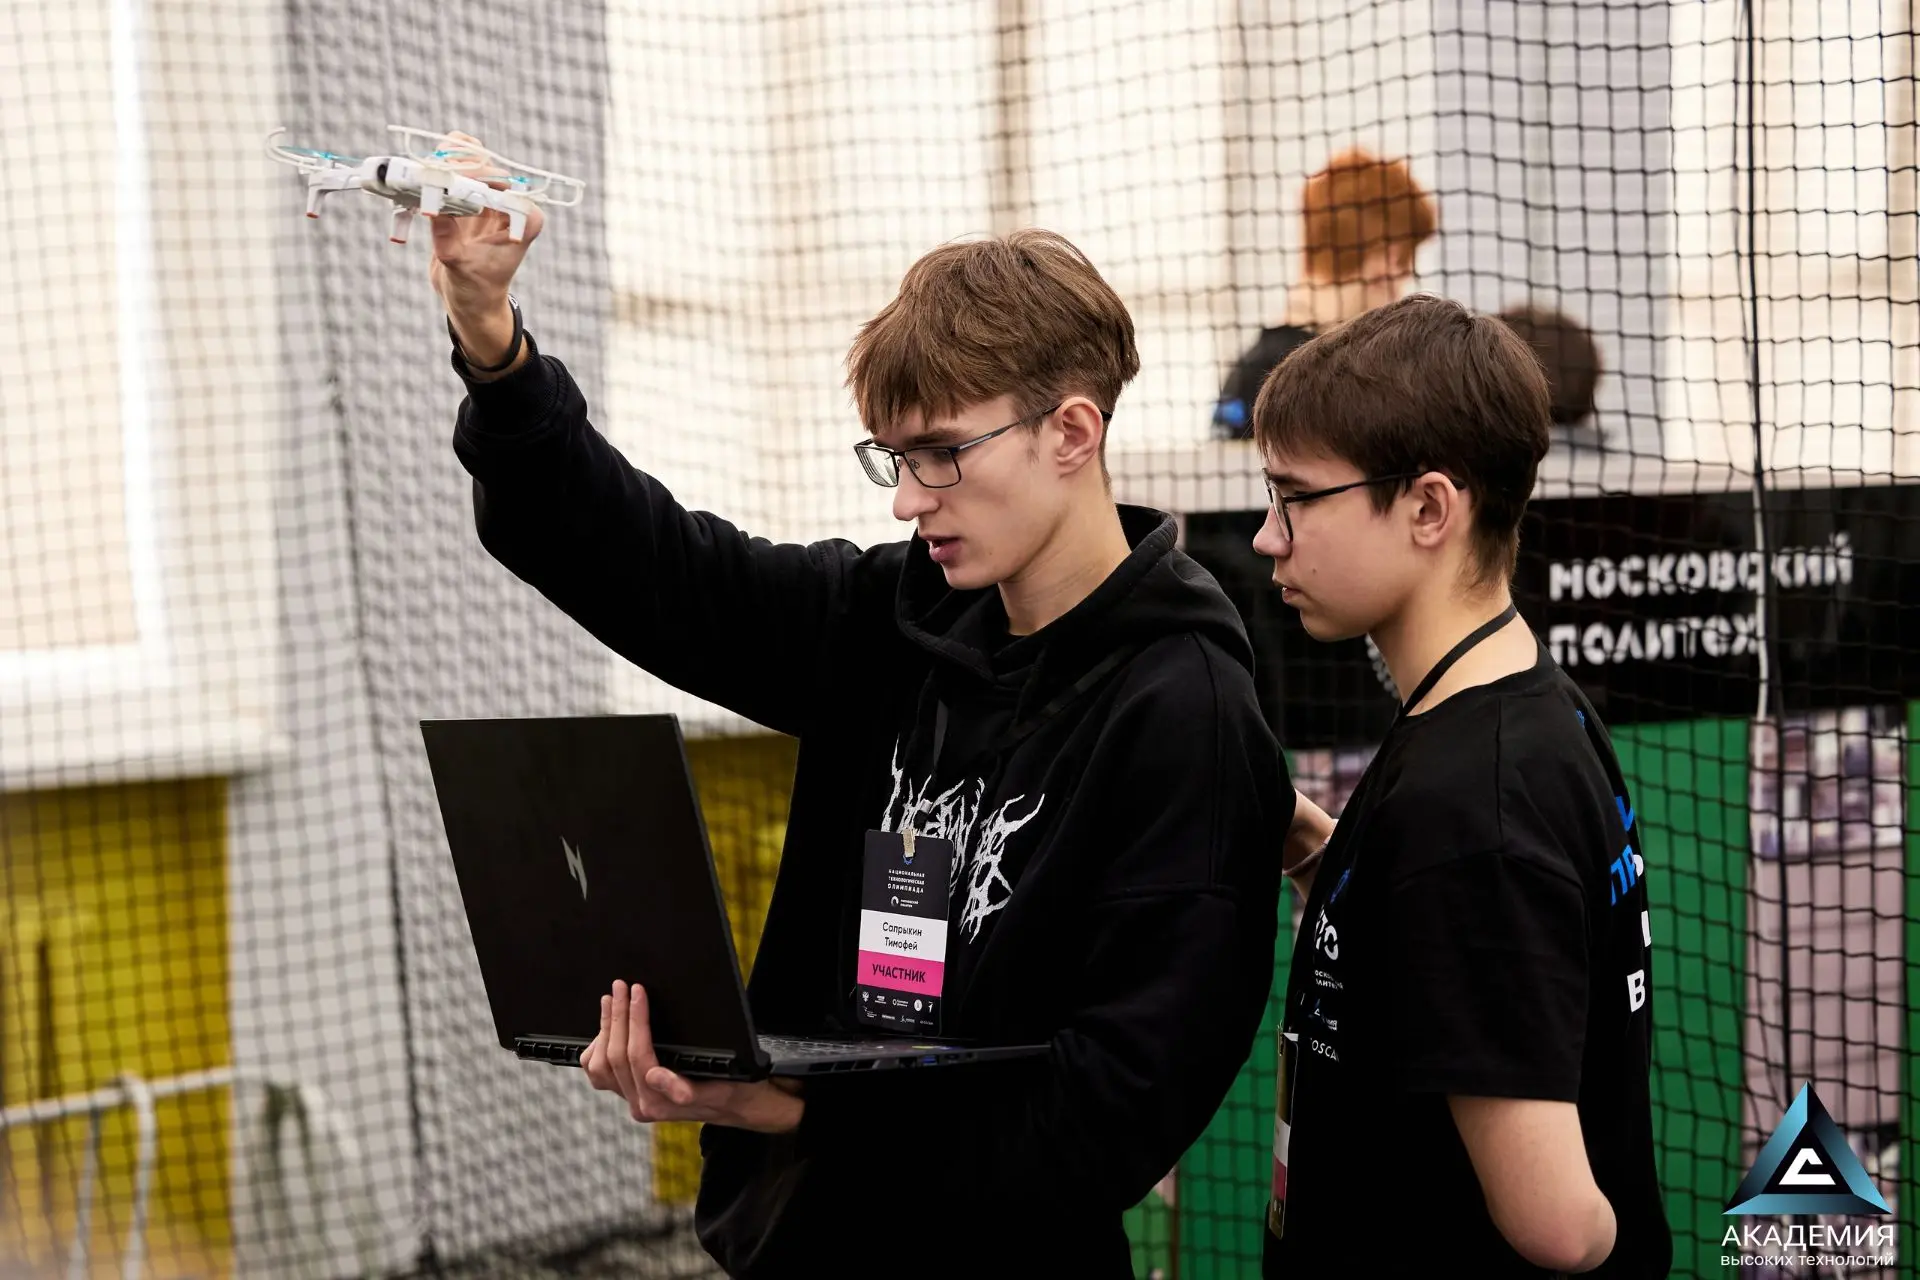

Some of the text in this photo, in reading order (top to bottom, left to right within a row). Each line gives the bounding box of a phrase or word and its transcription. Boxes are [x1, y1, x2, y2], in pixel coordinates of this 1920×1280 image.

[882, 921, 922, 936] Сапрыкин
[884, 936, 918, 951] Тимофей
[872, 963, 926, 983] УЧАСТНИК
